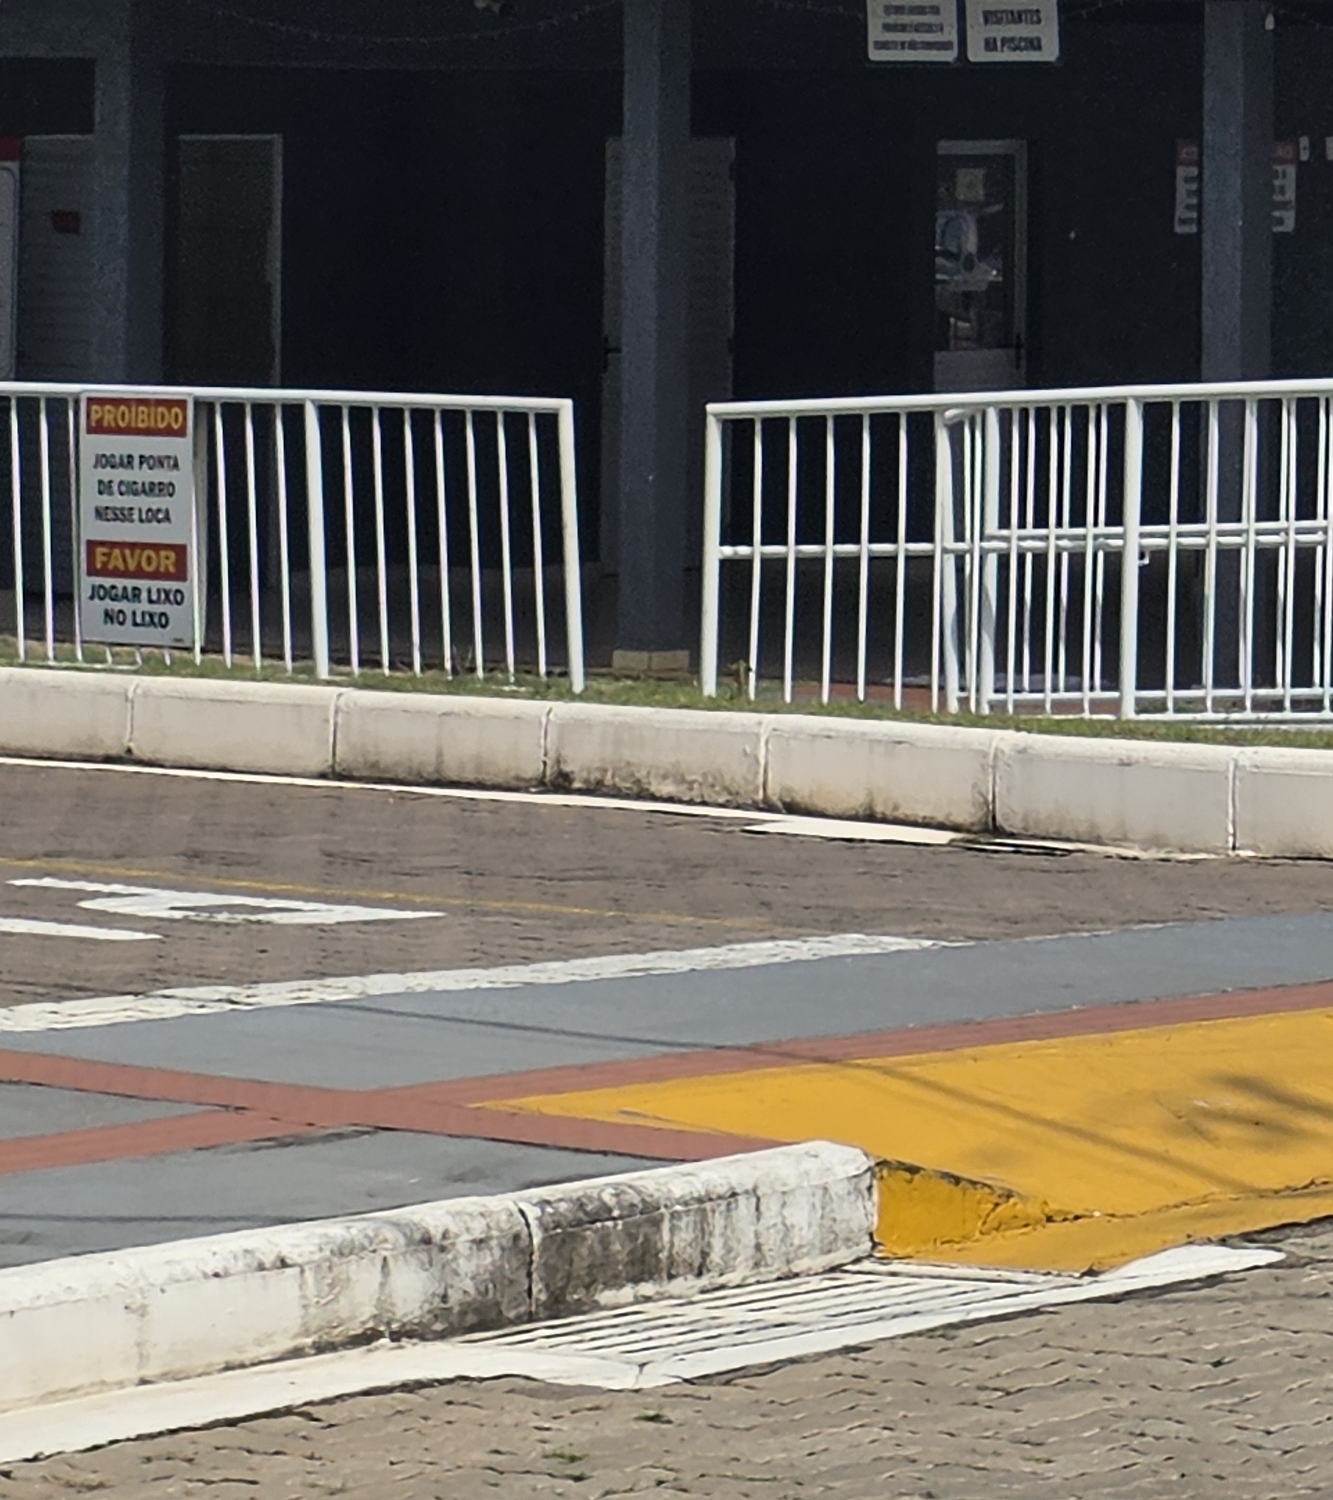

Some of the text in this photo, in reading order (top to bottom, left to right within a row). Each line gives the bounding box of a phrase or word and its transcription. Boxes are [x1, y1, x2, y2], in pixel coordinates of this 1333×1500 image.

[90, 404, 184, 430] PROIBIDO
[92, 453, 180, 471] JOGAR PONTA
[97, 479, 176, 498] DE CIGARRO
[94, 506, 136, 523] NESSE
[94, 547, 177, 573] FAVOR
[88, 584, 185, 606] JOGAR LIXO
[104, 608, 170, 629] NO LIXO
